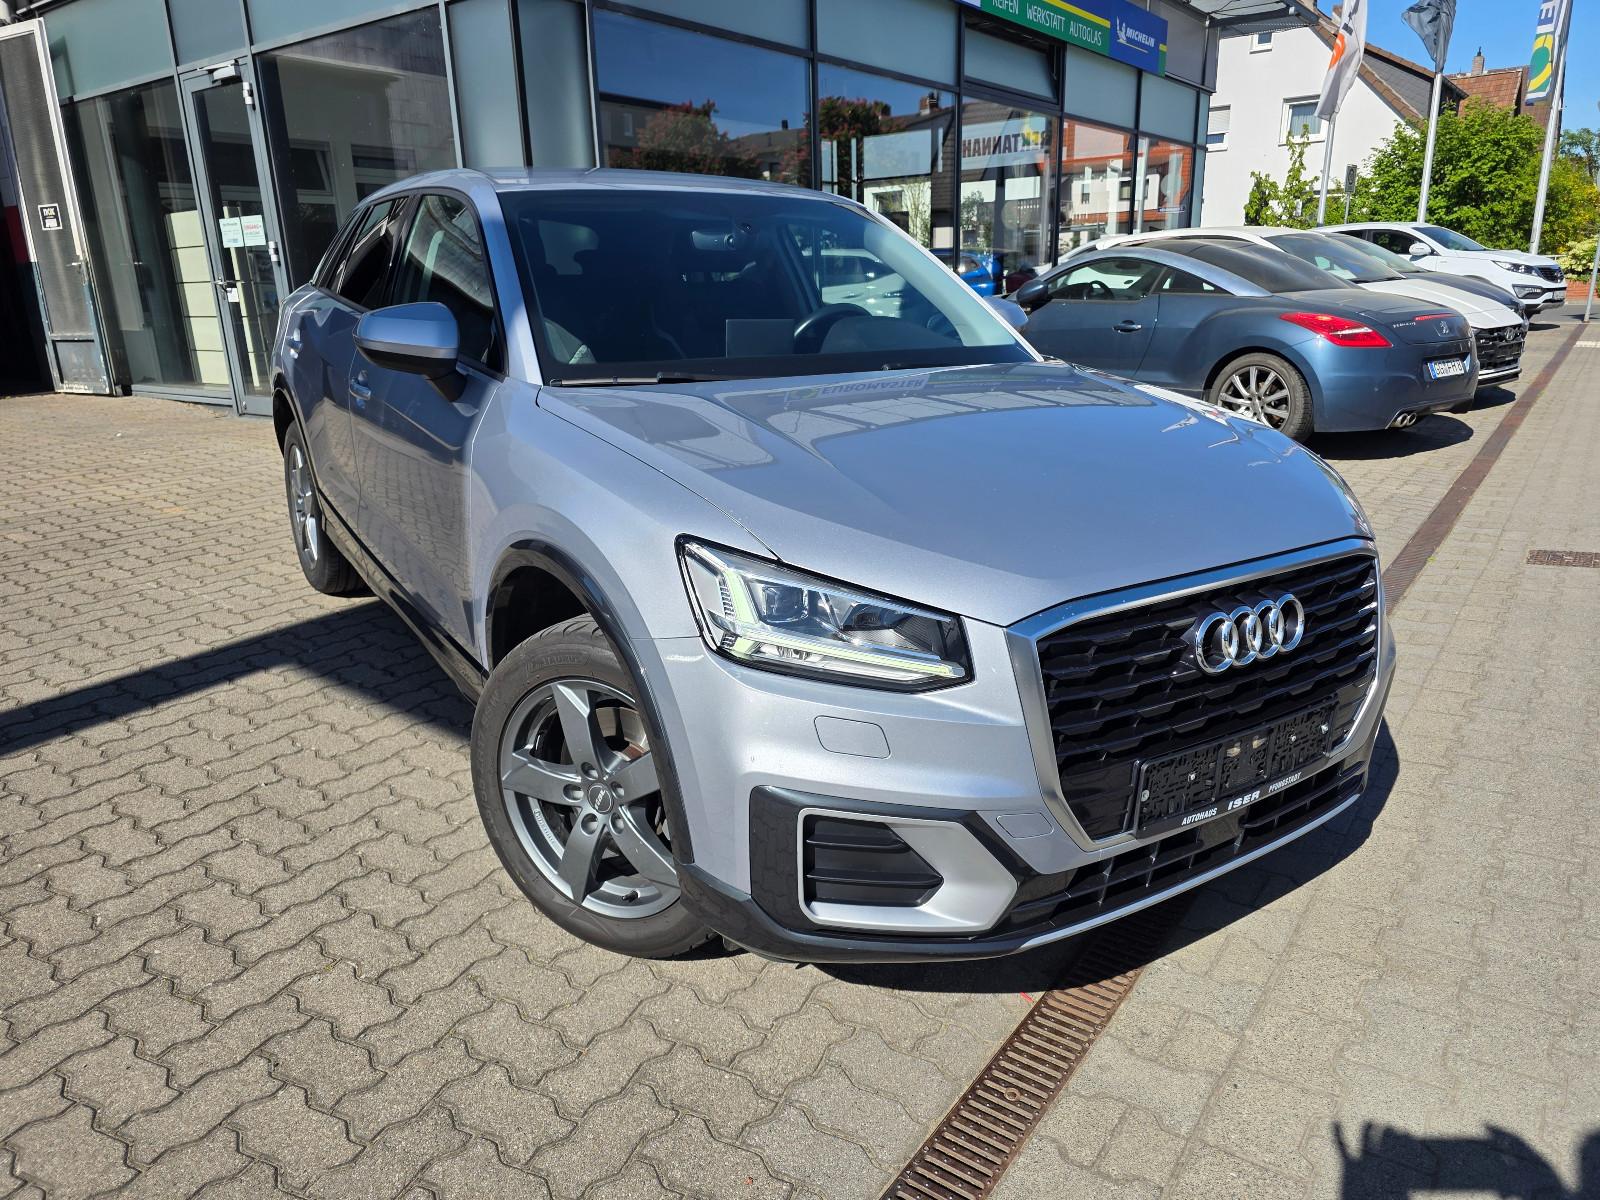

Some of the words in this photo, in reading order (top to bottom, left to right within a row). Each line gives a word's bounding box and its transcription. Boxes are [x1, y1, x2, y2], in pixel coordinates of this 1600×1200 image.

[1026, 3, 1066, 32] WERKSTATT
[1069, 20, 1102, 46] AUTOGLAS
[1126, 27, 1155, 48] MICHELIN
[1181, 807, 1218, 826] AUTOHAUS
[1227, 790, 1260, 811] ISER
